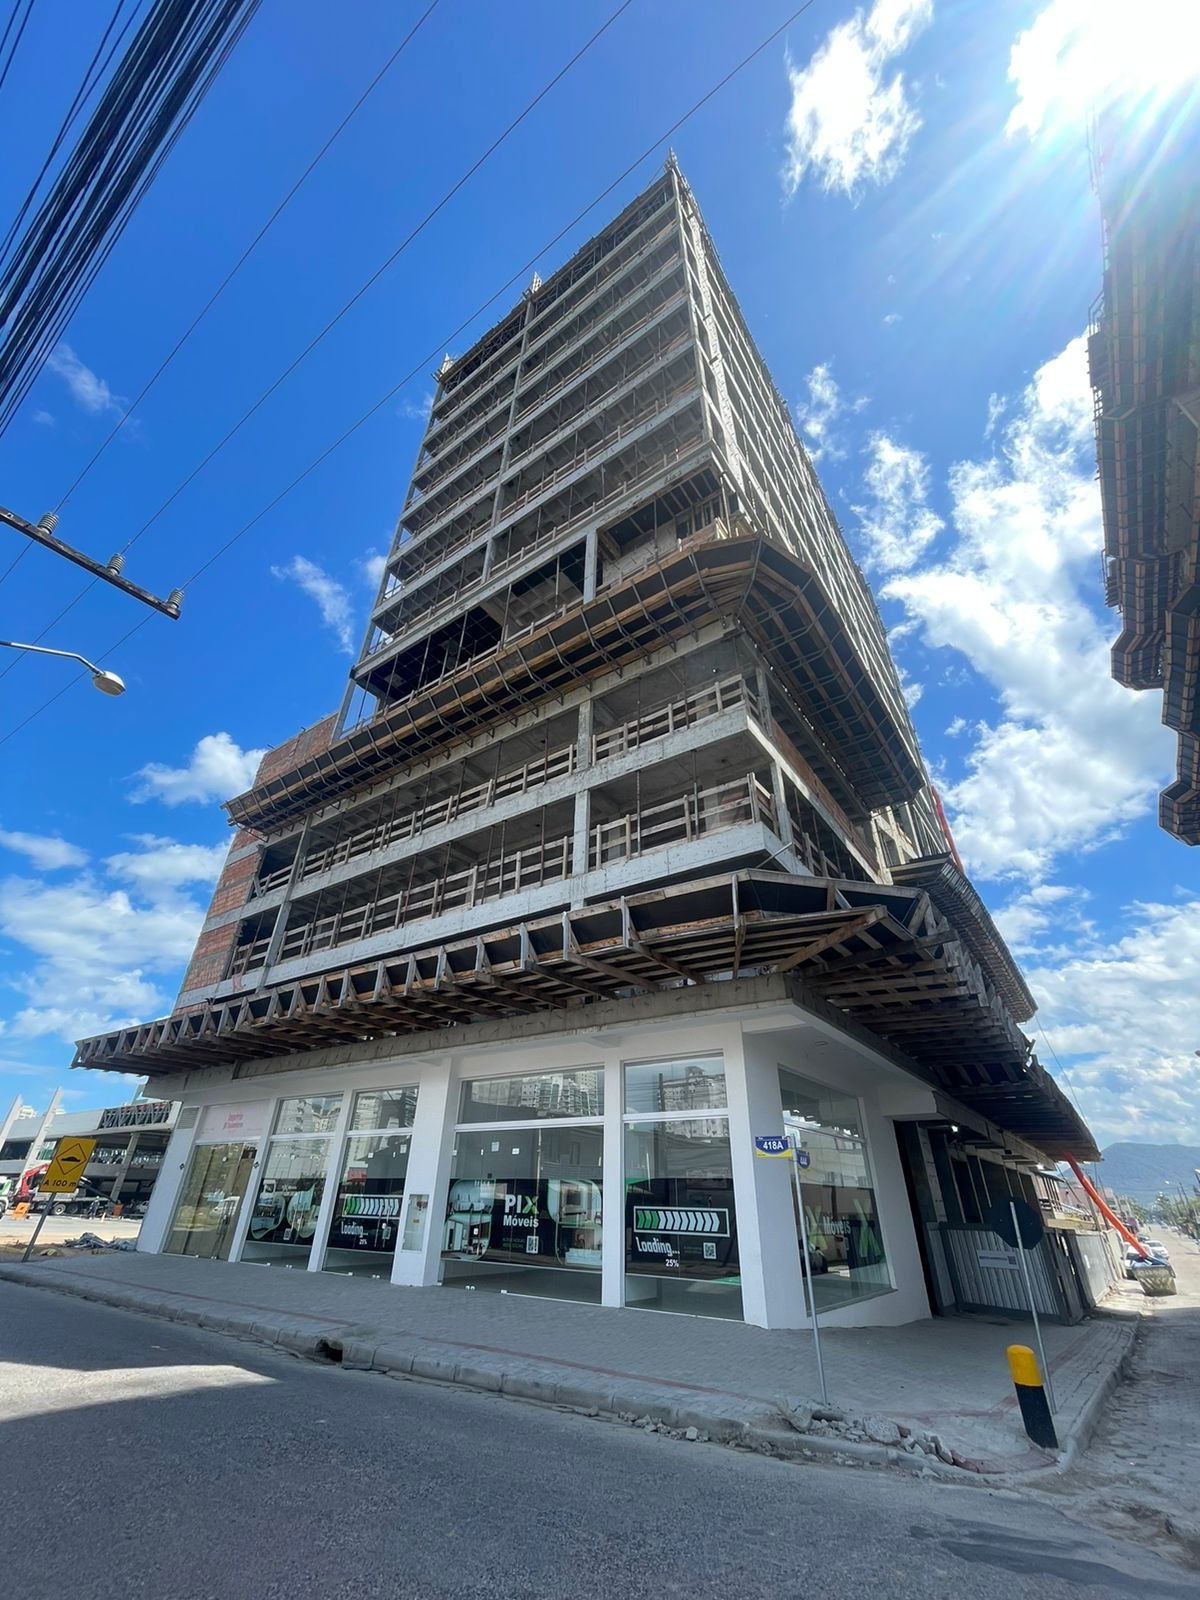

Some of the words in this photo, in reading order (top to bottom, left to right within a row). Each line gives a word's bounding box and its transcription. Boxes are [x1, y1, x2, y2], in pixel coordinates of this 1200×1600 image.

[763, 1141, 784, 1150] 418A
[52, 1179, 68, 1187] 100
[504, 1194, 539, 1215] PIX
[503, 1214, 539, 1228] Móveis
[665, 1259, 680, 1268] 25%
